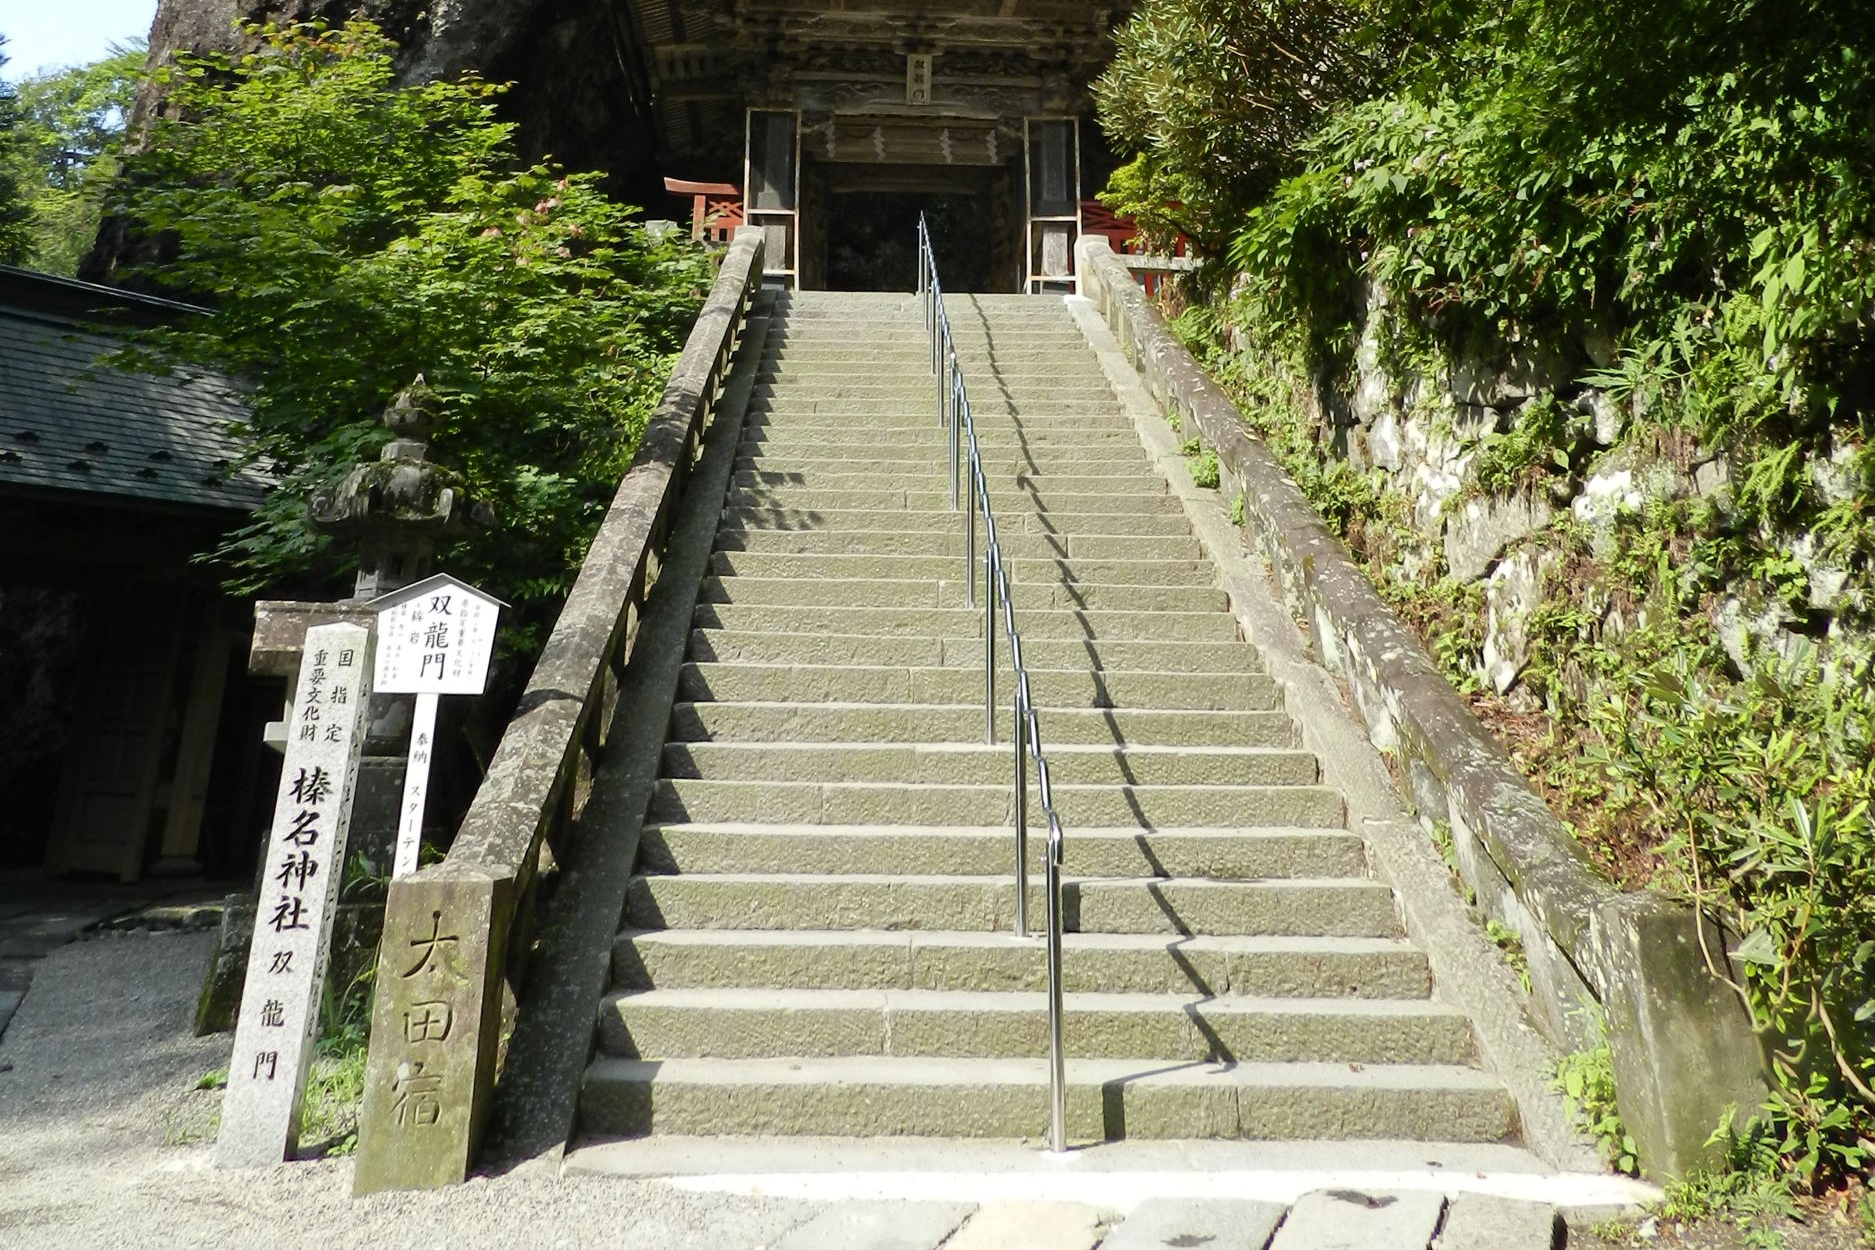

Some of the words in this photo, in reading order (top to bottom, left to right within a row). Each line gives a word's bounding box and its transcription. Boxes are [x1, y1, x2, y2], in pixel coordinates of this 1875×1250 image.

[420, 595, 452, 681] 双龍門
[299, 649, 329, 741] 重要文化財
[324, 649, 353, 743] 国指定
[412, 732, 429, 764] 奉納
[268, 766, 334, 933] 榛名神社
[253, 950, 294, 1080] 双龍門
